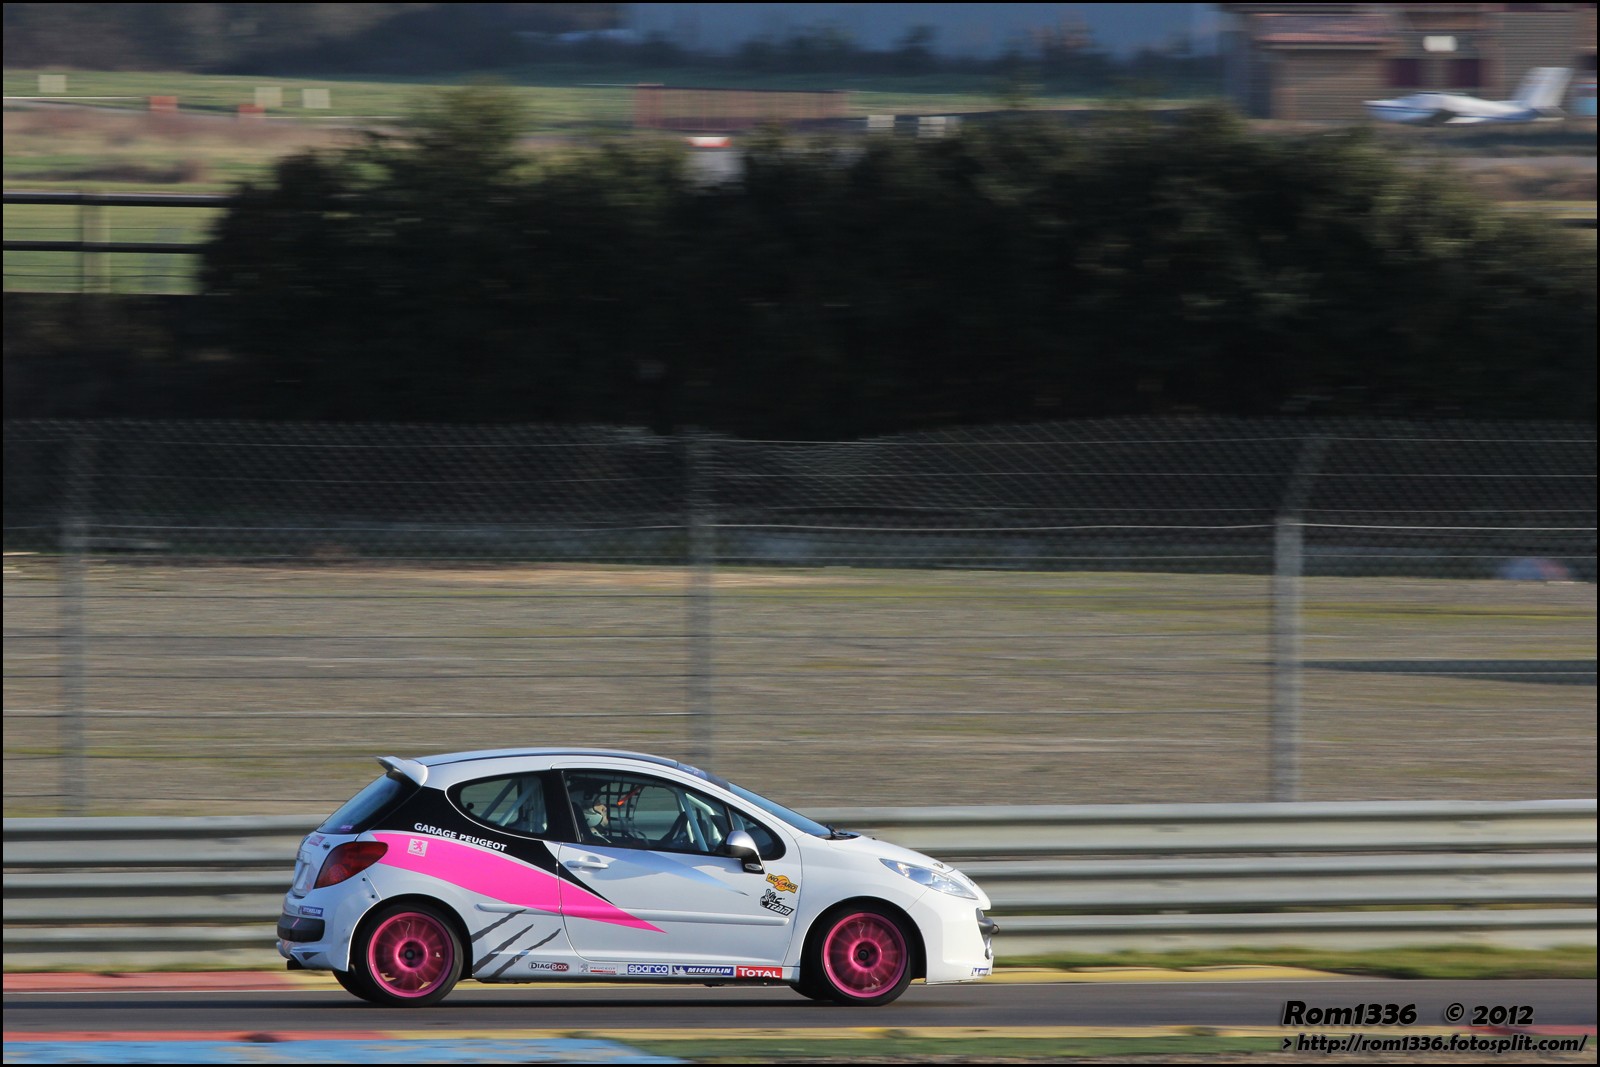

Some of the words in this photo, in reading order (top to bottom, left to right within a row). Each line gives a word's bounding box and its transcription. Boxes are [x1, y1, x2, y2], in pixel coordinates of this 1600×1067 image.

[414, 822, 457, 839] GARAGE
[459, 833, 507, 852] PEUGEOT
[628, 964, 668, 973] sparco
[738, 967, 781, 978] TOTAL
